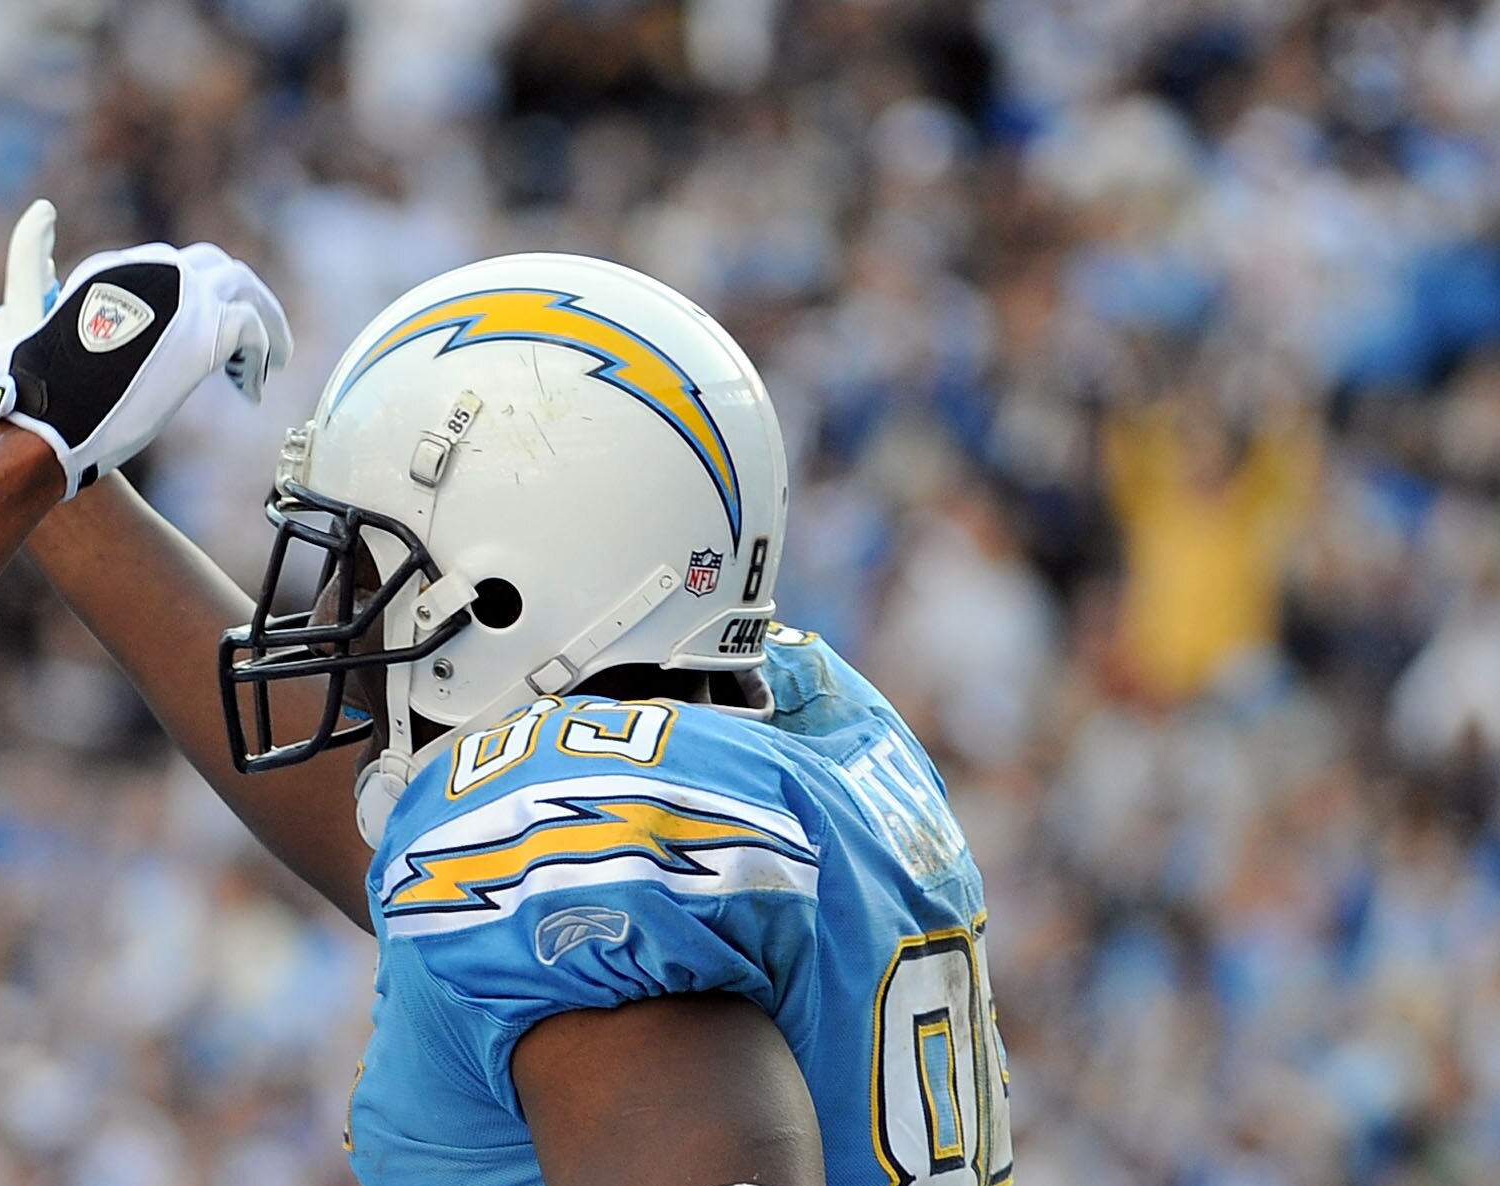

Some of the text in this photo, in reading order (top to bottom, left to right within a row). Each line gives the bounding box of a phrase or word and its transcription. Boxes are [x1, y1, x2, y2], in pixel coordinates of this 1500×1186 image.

[447, 407, 470, 434] 85
[687, 568, 716, 592] NFL
[445, 694, 680, 801] 85
